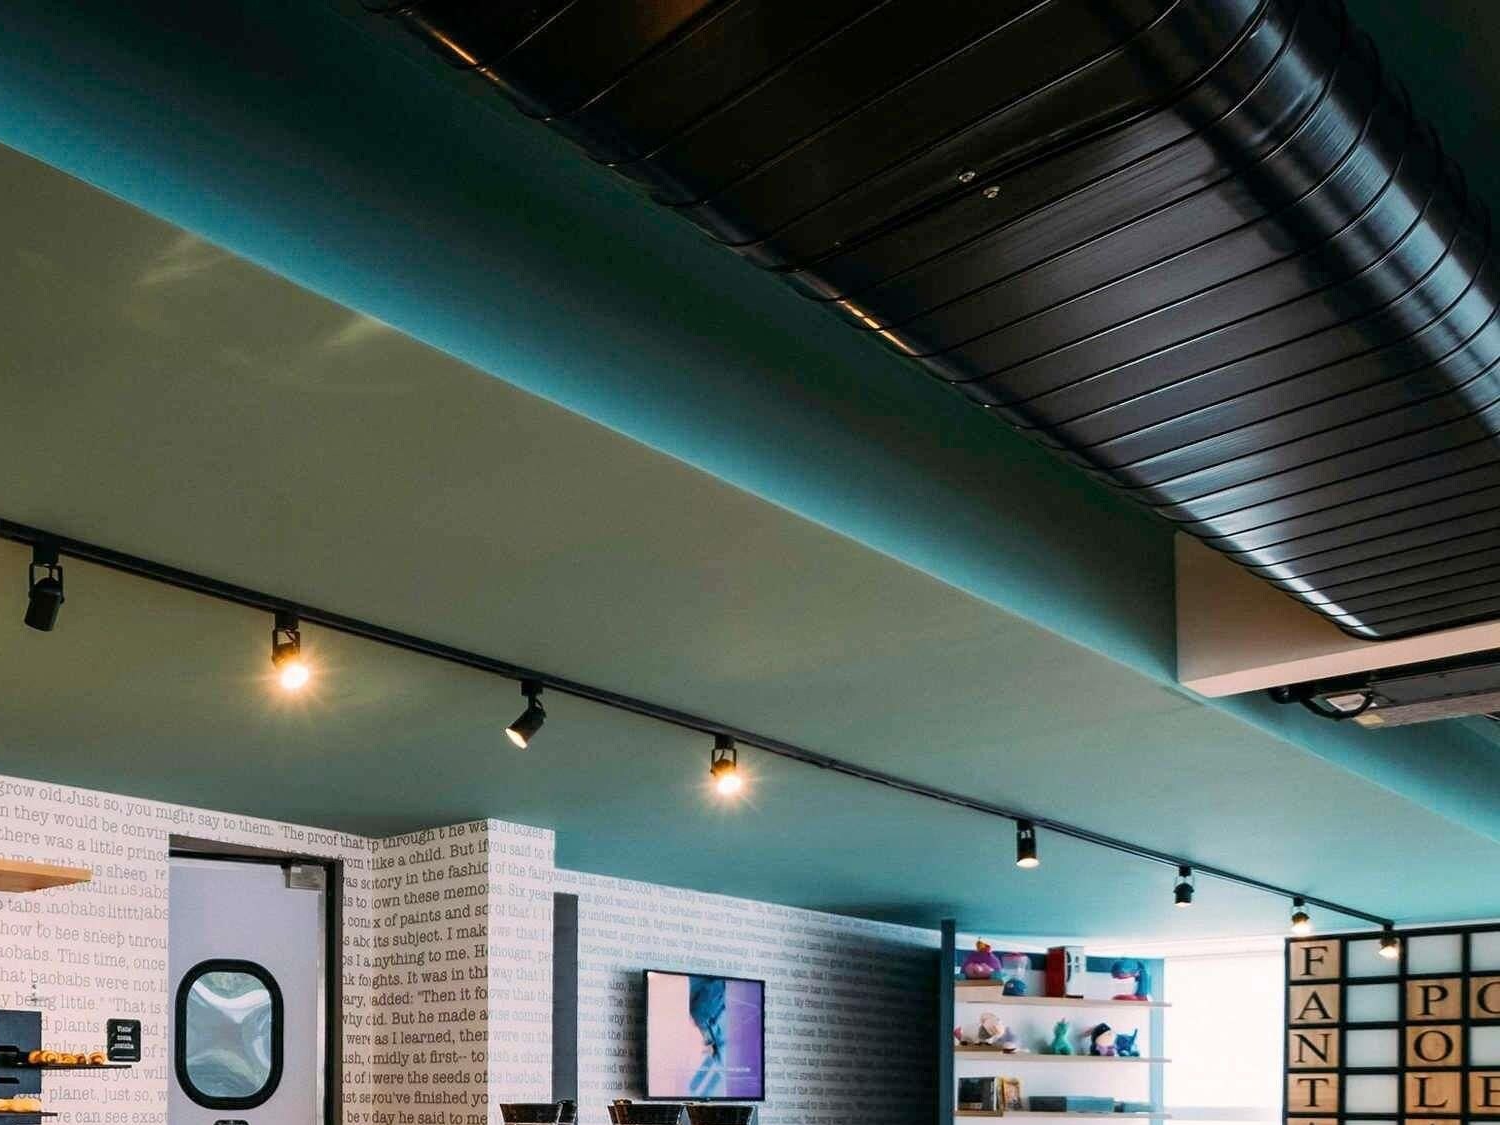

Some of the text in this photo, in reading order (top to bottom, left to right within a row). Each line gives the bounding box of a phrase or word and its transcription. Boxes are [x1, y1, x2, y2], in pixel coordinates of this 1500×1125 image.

[13, 804, 52, 826] they
[53, 811, 98, 831] would
[101, 815, 118, 833] be
[44, 834, 74, 850] was
[77, 839, 86, 852] a
[89, 837, 124, 857] little
[127, 843, 169, 863] prince
[392, 929, 444, 951] subject.
[371, 986, 471, 1006] added: "Then it
[391, 1006, 476, 1025] But he made
[400, 1029, 456, 1046] learned,
[413, 1052, 427, 1065] at
[373, 1069, 488, 1085] were the seeds of
[416, 1091, 470, 1105] finished
[399, 1111, 414, 1125] he
[418, 1111, 445, 1125] said
[449, 1112, 464, 1125] to
[466, 1114, 488, 1125] me
